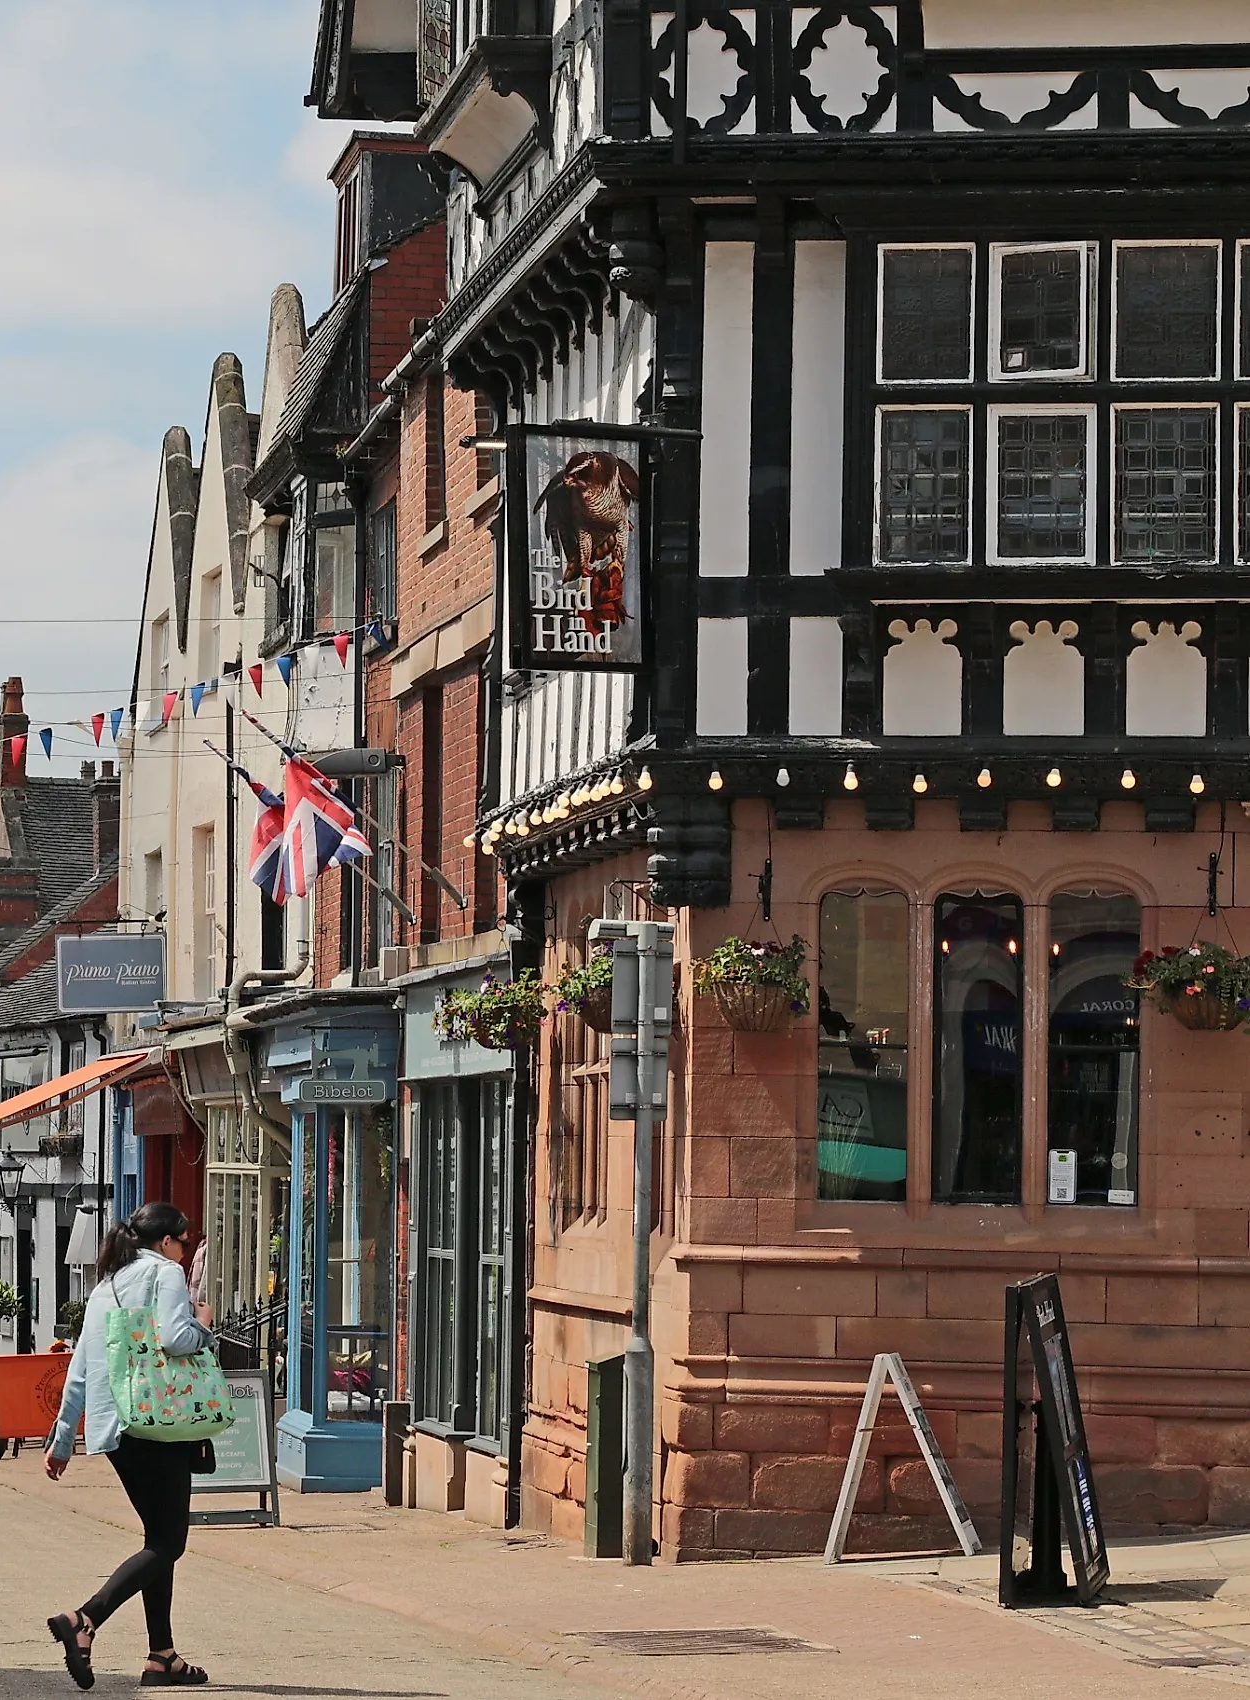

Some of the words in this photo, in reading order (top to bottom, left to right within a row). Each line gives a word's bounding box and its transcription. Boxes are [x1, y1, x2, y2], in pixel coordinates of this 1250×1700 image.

[532, 548, 561, 568] The
[532, 571, 593, 611] Bird
[568, 611, 587, 631] in
[532, 613, 612, 653] Hand
[313, 1085, 374, 1098] Bibelot
[34, 1366, 56, 1392] Pronto
